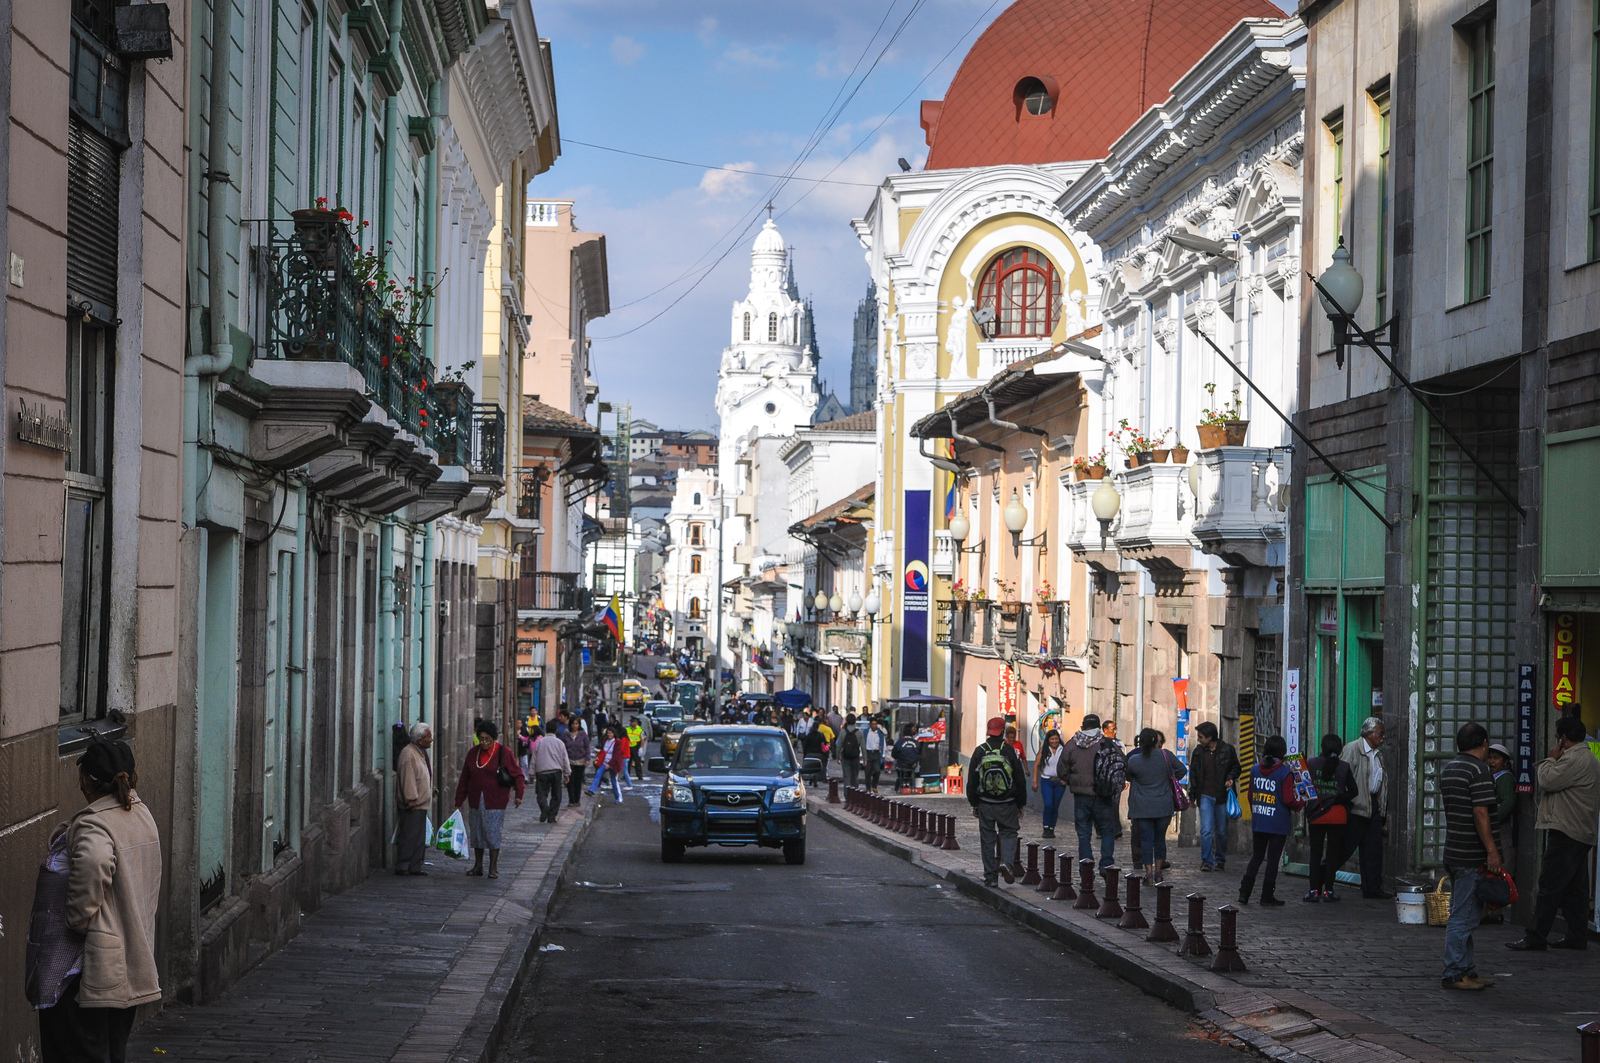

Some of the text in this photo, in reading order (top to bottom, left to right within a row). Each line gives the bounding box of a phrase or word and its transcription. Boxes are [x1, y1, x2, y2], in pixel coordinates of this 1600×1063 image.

[999, 663, 1007, 714] RELOJERIA
[1556, 614, 1573, 706] COPIAS
[1289, 691, 1297, 754] fashio
[1519, 666, 1532, 783] PAPELERIA
